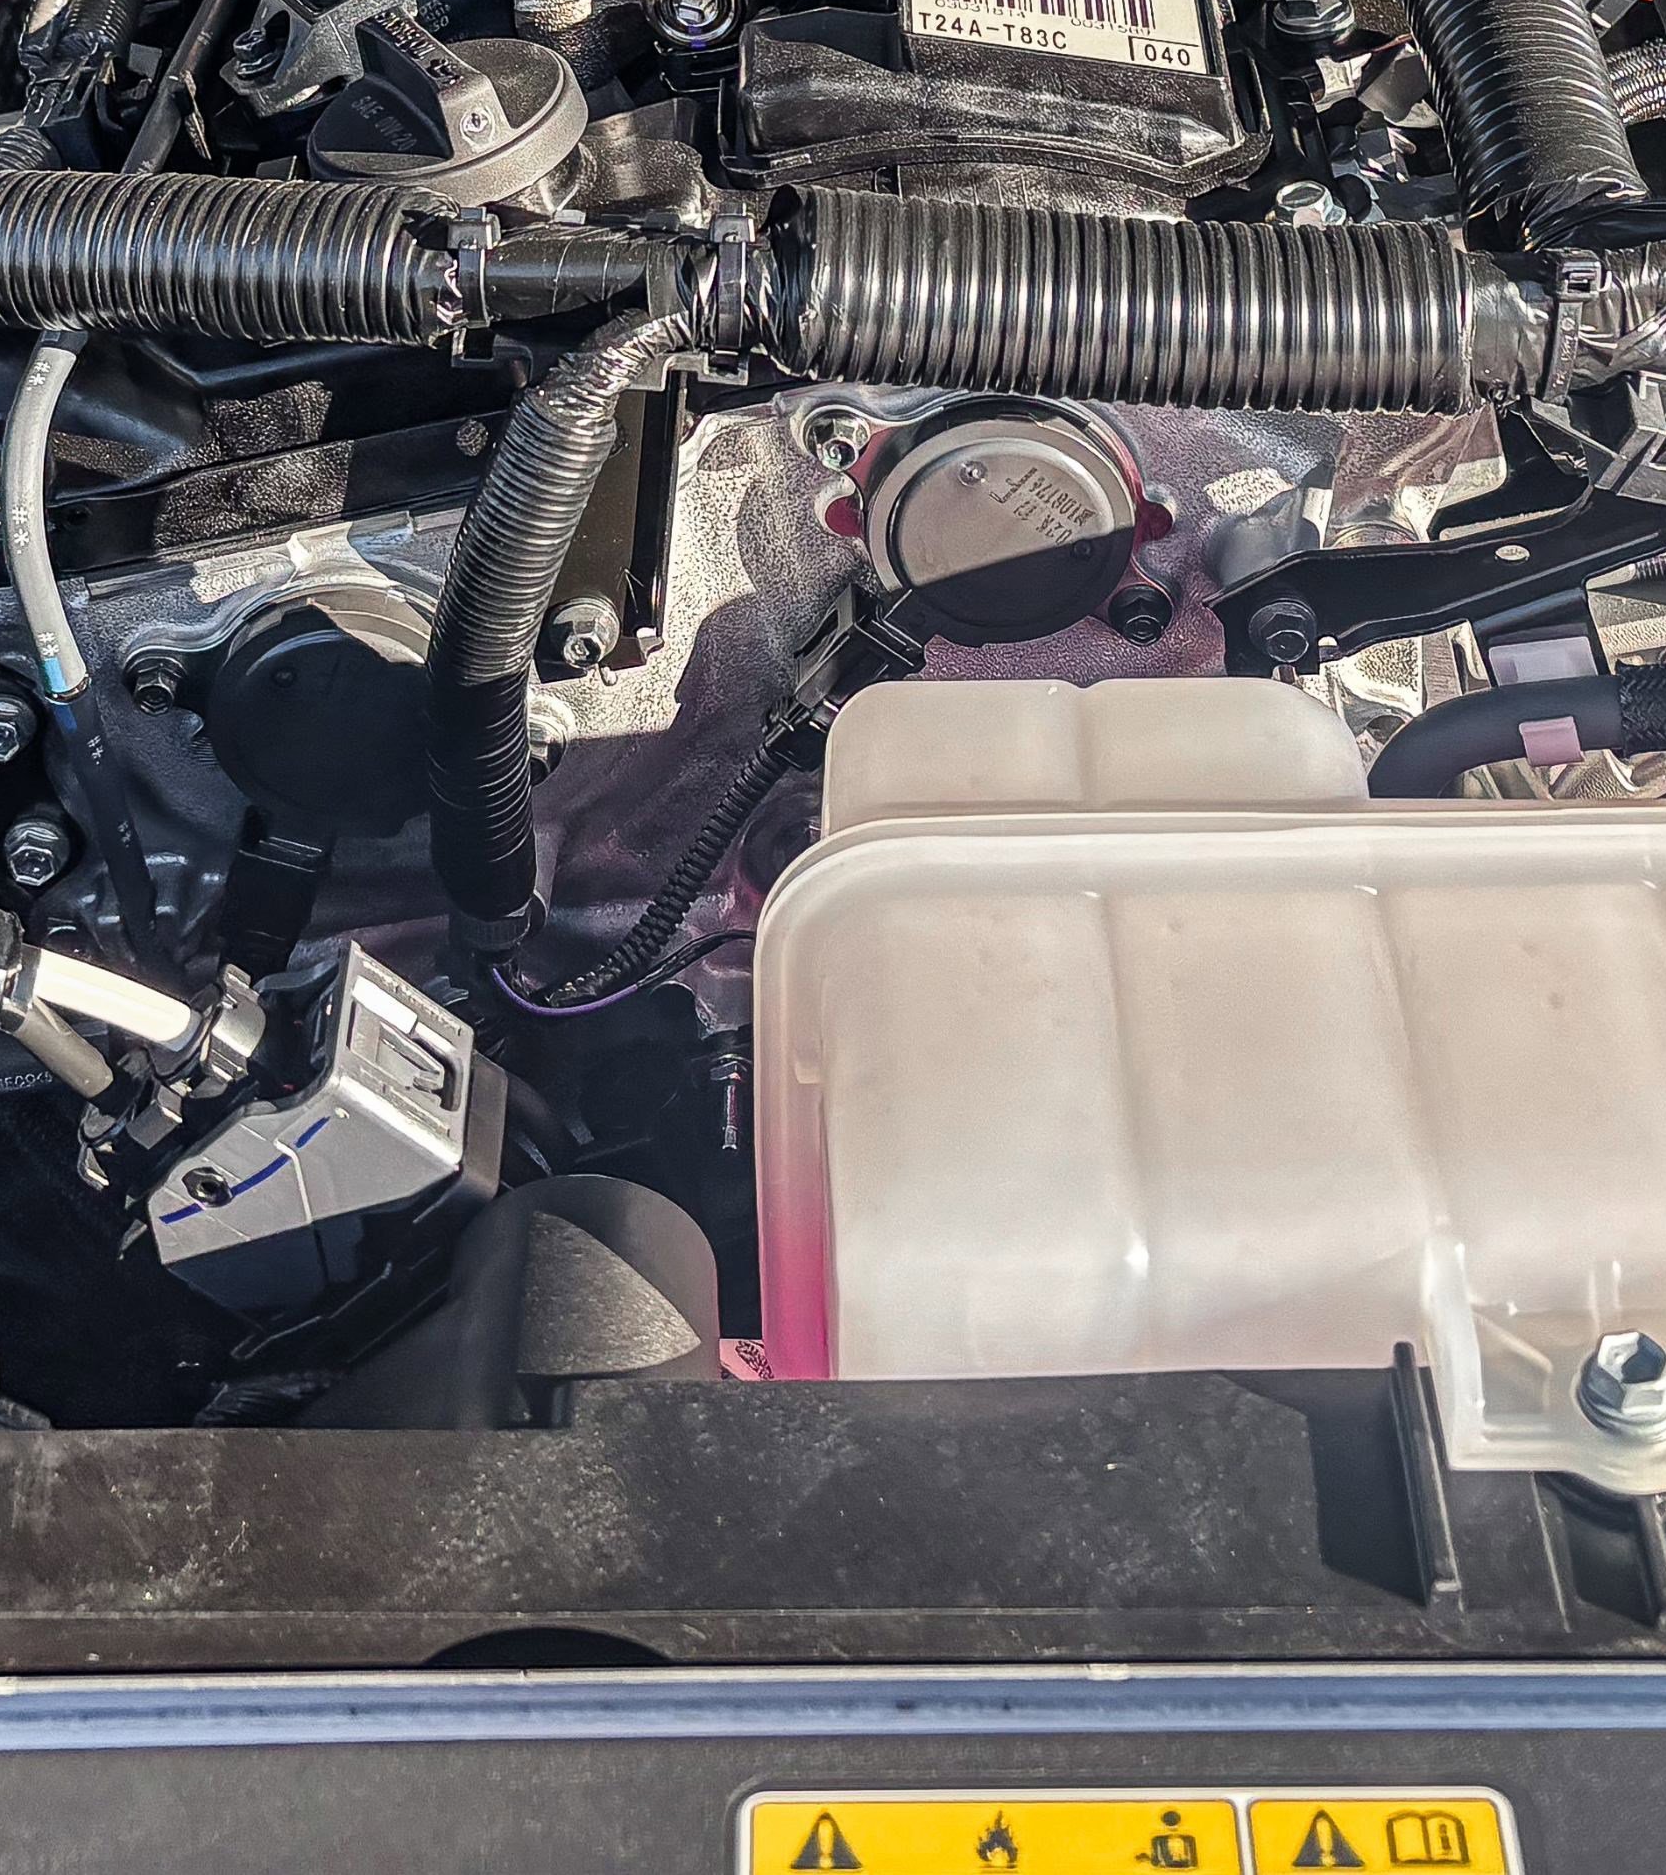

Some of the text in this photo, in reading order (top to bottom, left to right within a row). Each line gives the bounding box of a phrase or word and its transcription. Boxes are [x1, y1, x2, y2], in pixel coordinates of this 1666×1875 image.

[918, 11, 1068, 50] T24A-T83C
[1144, 43, 1191, 66] 040
[351, 95, 385, 121] SAE
